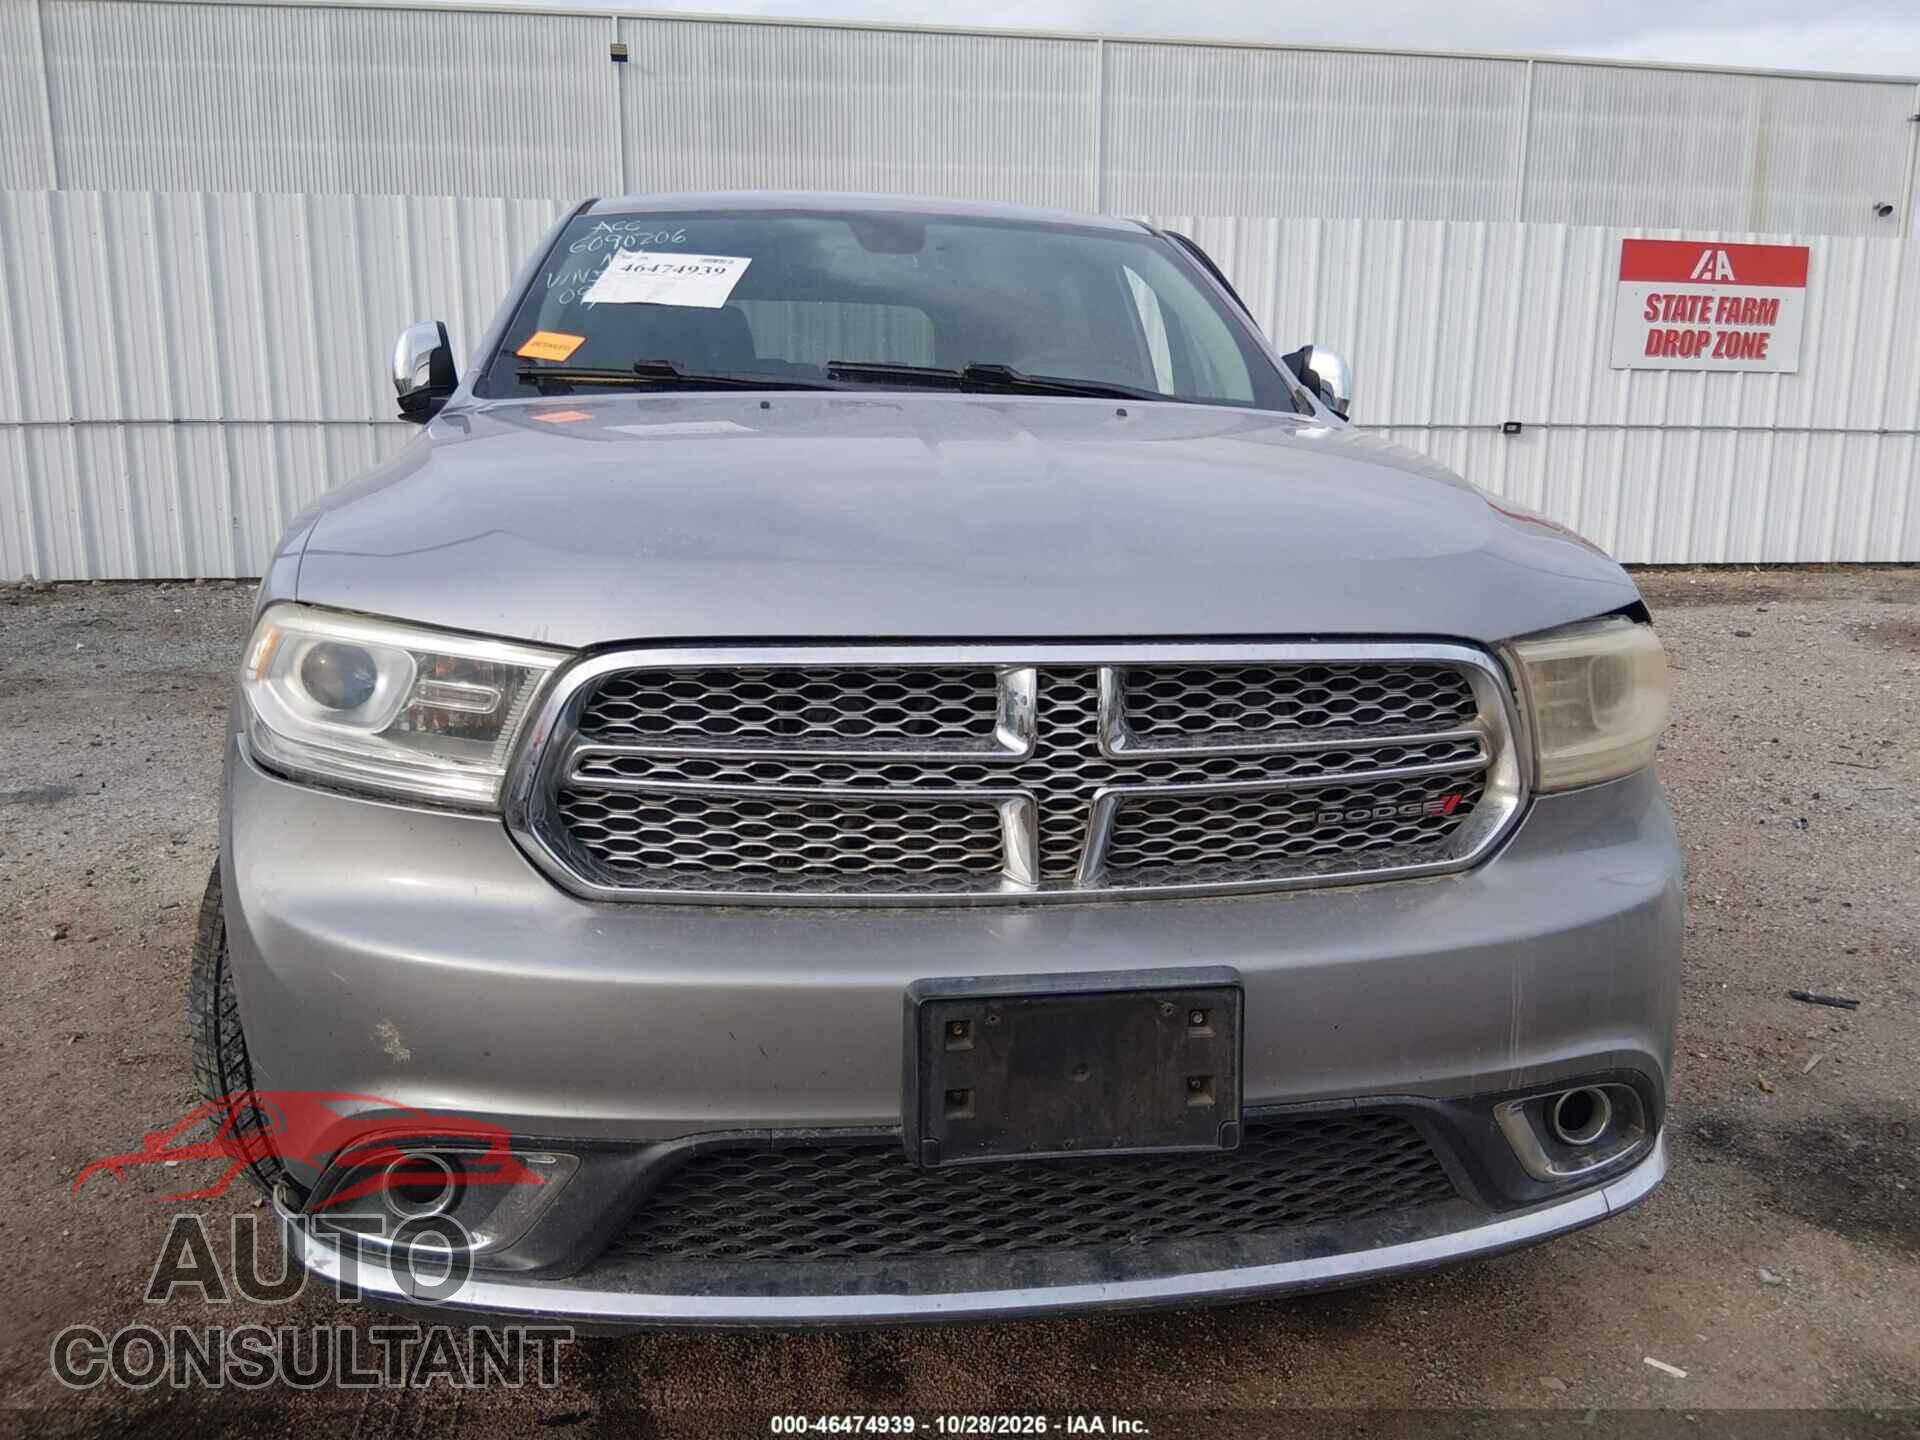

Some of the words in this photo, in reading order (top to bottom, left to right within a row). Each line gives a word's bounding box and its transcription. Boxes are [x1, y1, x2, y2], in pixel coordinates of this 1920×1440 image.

[621, 262, 727, 276] 46474939
[1644, 293, 1715, 325] STATE
[1715, 296, 1780, 326] FARM
[1645, 328, 1712, 359] DROP
[1711, 330, 1771, 360] ZONE
[1317, 800, 1446, 827] DODGE
